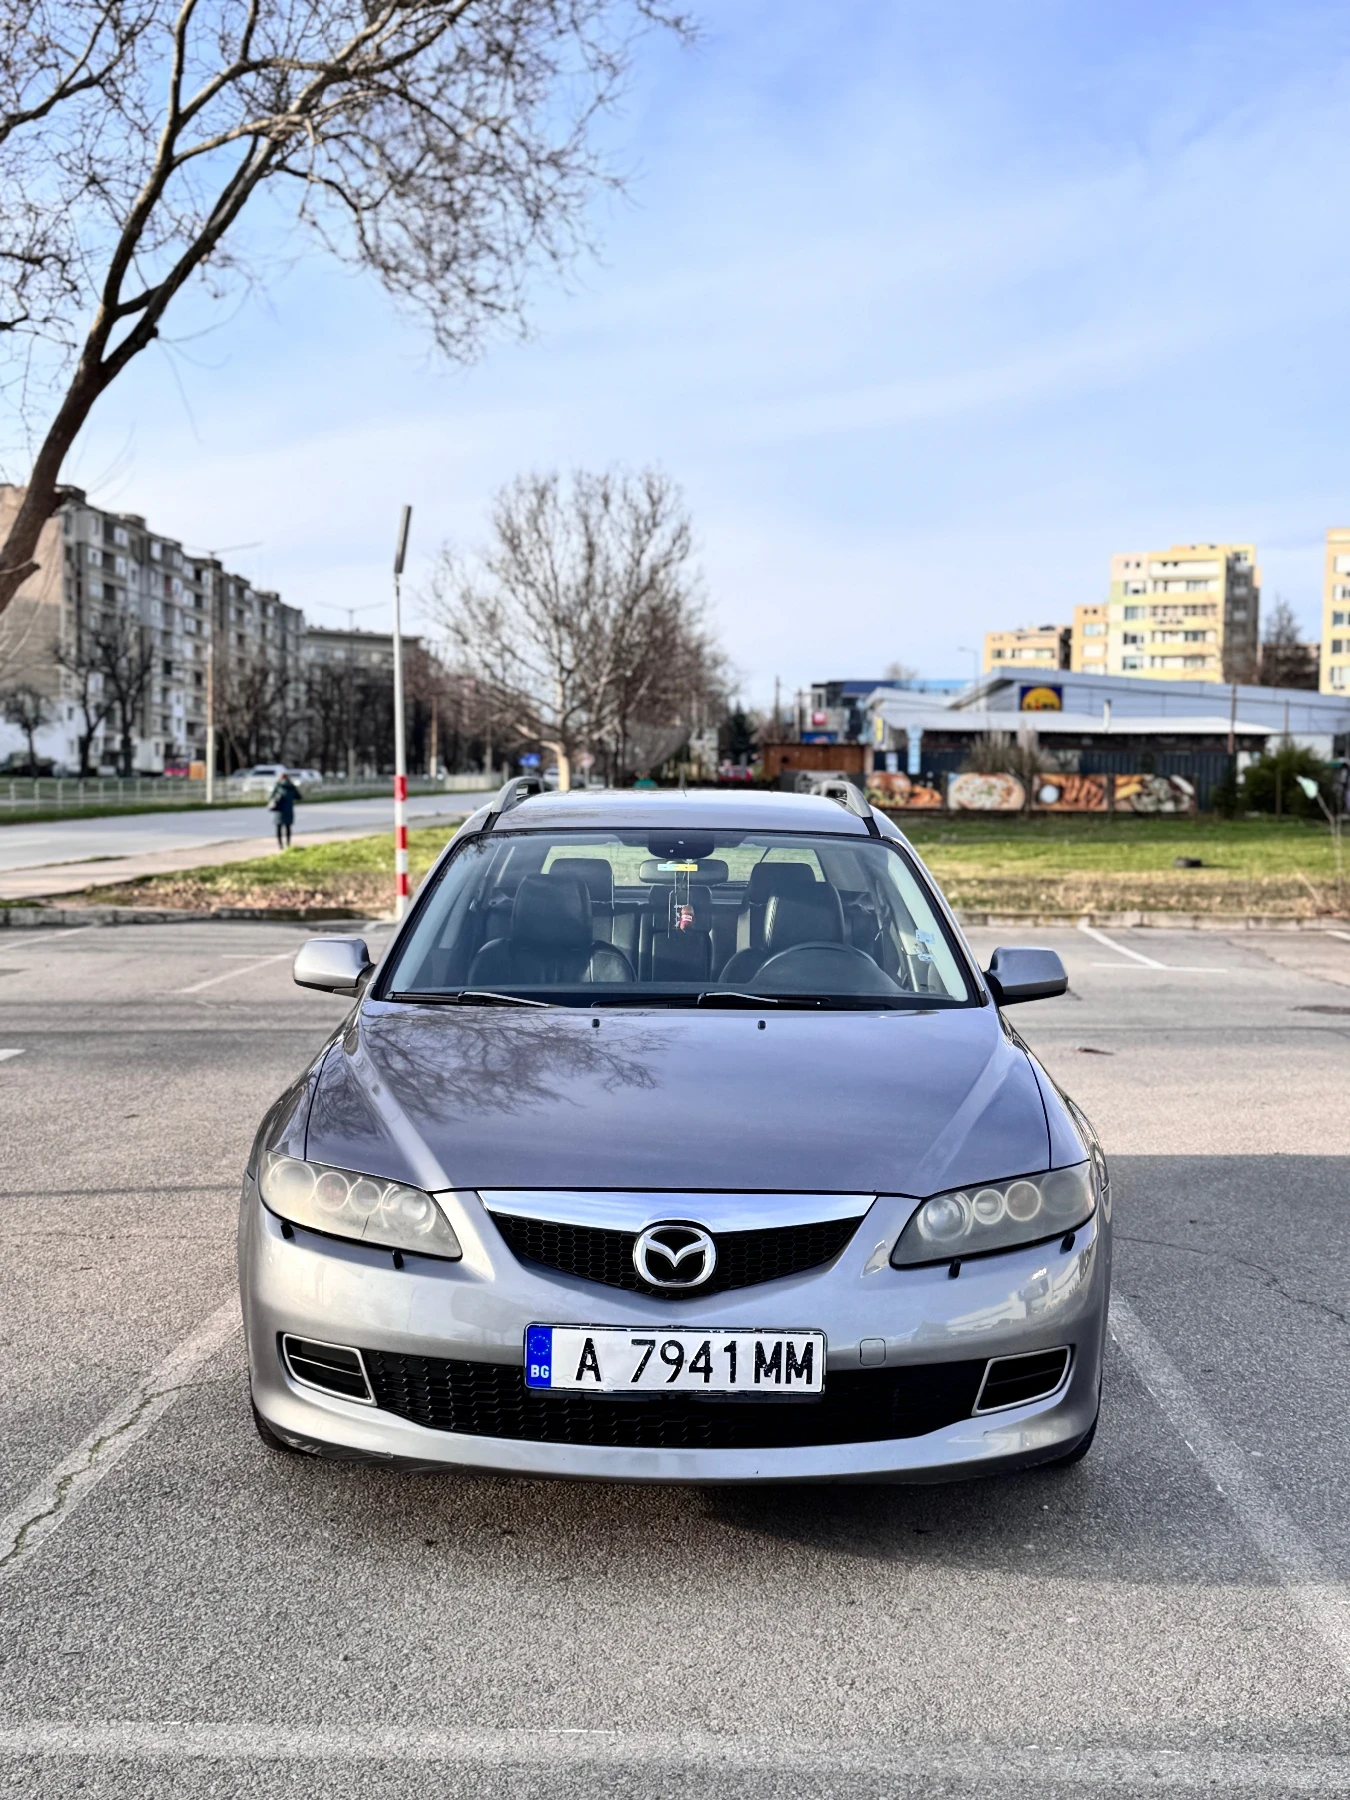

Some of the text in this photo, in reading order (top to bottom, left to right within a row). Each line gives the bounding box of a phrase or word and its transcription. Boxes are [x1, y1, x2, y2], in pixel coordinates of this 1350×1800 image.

[530, 1365, 549, 1378] BG
[575, 1338, 814, 1385] A 7941 MM
